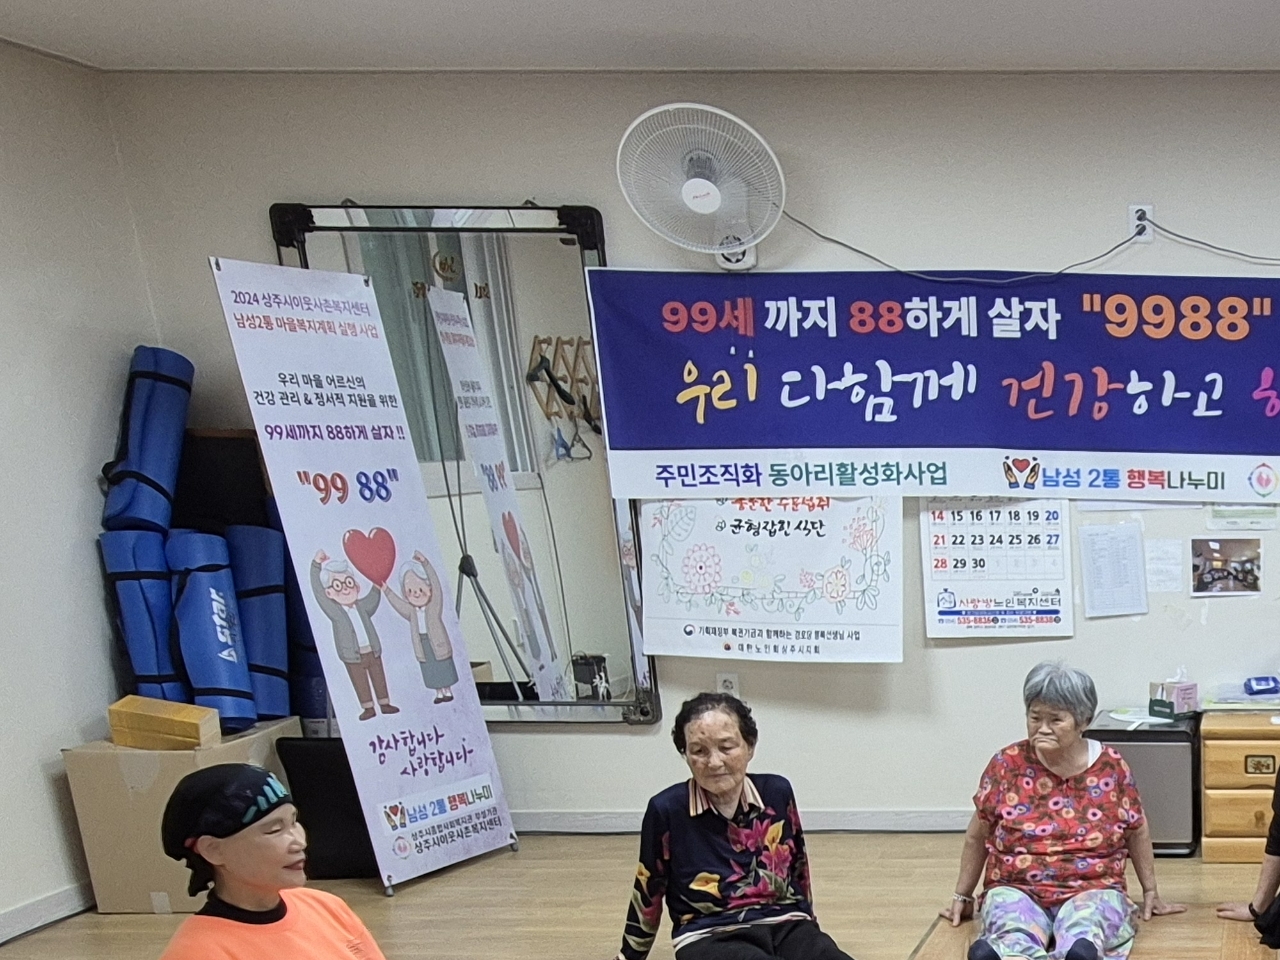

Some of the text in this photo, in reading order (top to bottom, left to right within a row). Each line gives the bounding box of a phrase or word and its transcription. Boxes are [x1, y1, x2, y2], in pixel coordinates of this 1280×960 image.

[231, 290, 371, 317] 2024 상주시이웃사촌복지센터
[233, 312, 274, 331] 남성2통
[275, 316, 337, 335] 마을복지계획
[360, 323, 379, 339] 사업
[662, 293, 1272, 341] 99세 까지 88하게 살자 "9988"
[278, 371, 367, 390] 우리 마을 어르신의
[676, 359, 759, 425] 우리
[780, 358, 978, 423] 다함께
[1001, 360, 1224, 421] 건강하고
[252, 389, 399, 409] 건강 관리 & 정서적 지원을 위한
[264, 423, 325, 442] 99세까지
[325, 424, 369, 442] 88하게
[370, 424, 394, 441] 살자
[655, 461, 948, 488] 주민조직화 동아리활성화사업
[1042, 467, 1225, 490] 남성 2통 행복나누미
[931, 510, 1059, 521] 14 15 16 17 18 19 20
[730, 518, 826, 538] 균형잡힌 식단
[933, 534, 1060, 545] 21 22 23 24 25 26 27
[934, 558, 948, 569] 28
[952, 558, 967, 569] 29
[971, 558, 986, 569] 30
[369, 725, 445, 765] 감사합니다
[400, 744, 474, 777] 사랑합니다
[405, 803, 429, 824] 남성
[429, 798, 448, 818] 2통
